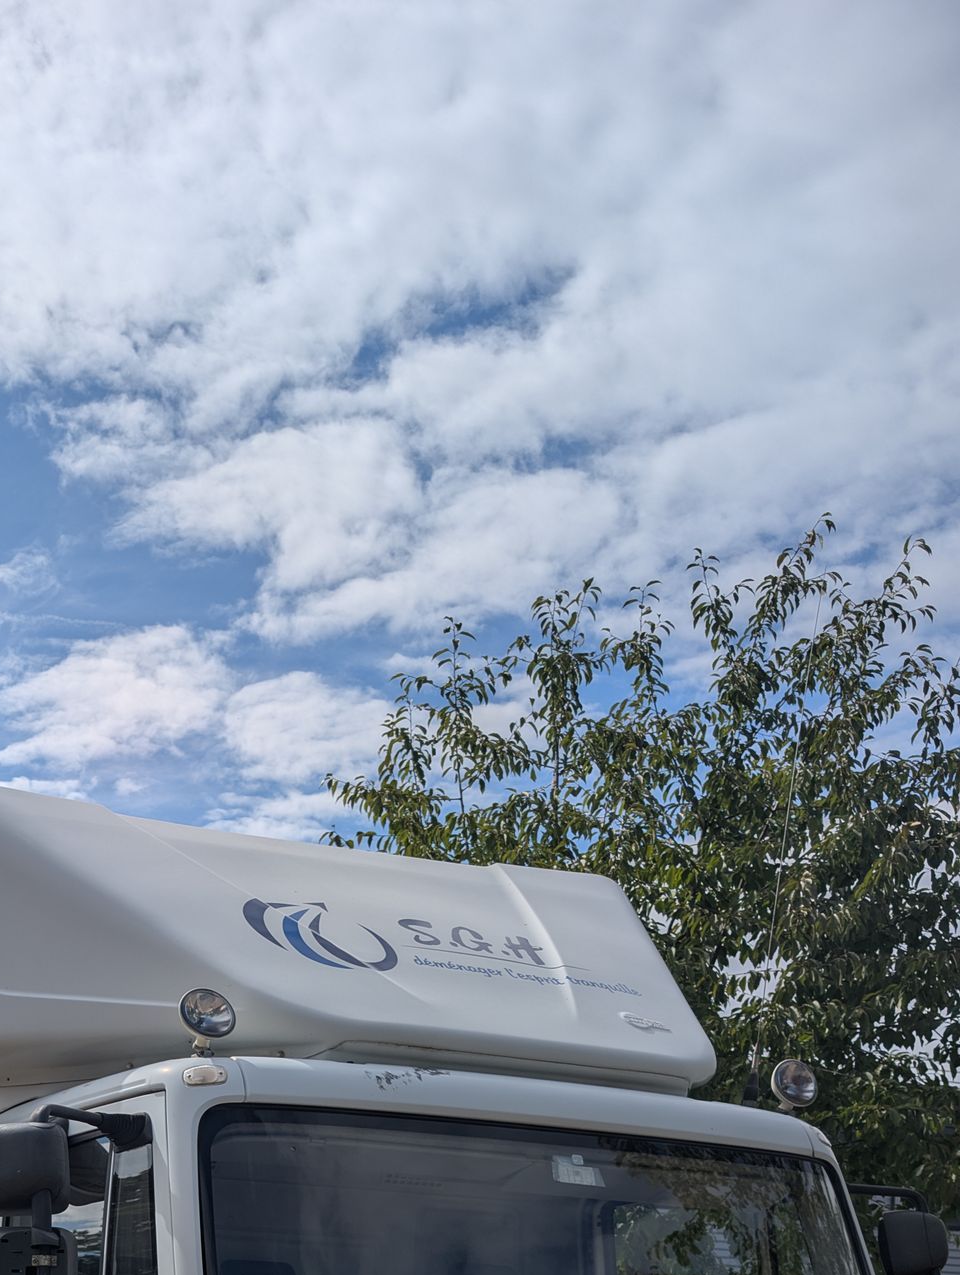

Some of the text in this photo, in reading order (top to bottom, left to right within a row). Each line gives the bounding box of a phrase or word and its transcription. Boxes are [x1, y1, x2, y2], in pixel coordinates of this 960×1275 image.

[397, 918, 545, 966] S.G.H
[414, 955, 642, 997] déménager l'esprit tranquille
